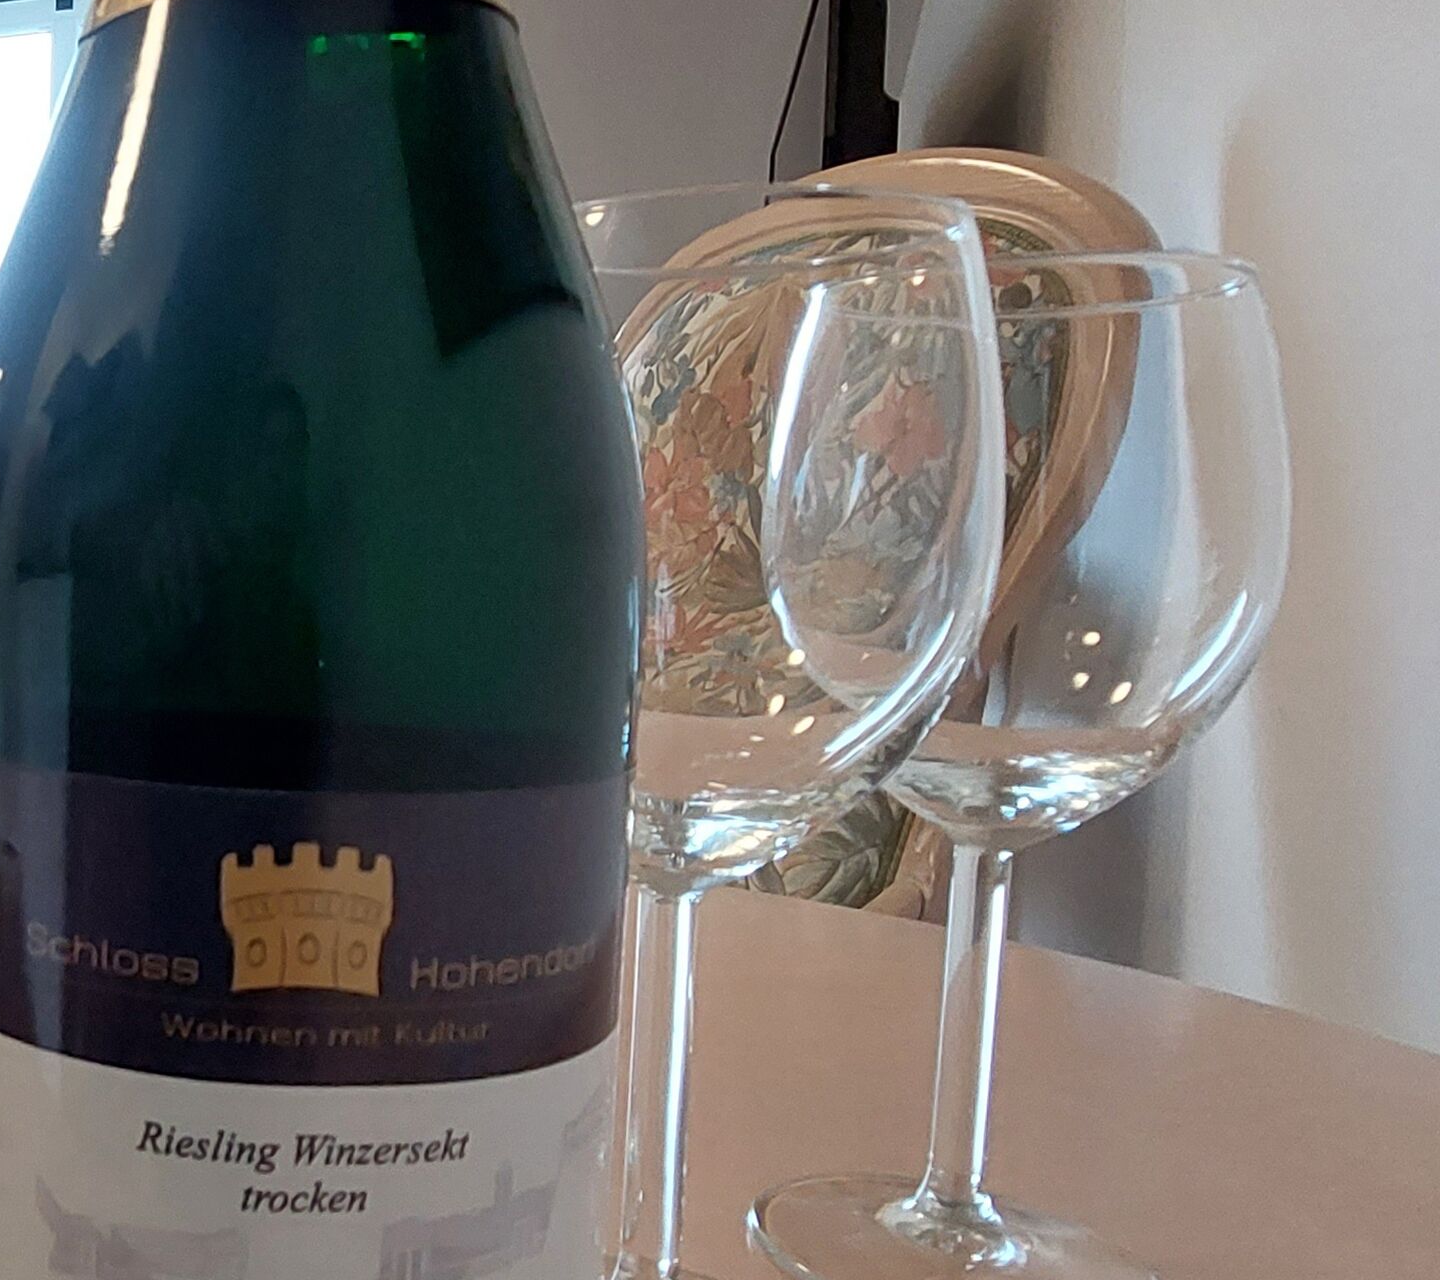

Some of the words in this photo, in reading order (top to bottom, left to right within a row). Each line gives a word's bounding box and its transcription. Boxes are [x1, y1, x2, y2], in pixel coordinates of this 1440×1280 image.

[24, 920, 200, 986] Schloss
[161, 1013, 317, 1047] Wohnen
[328, 1023, 385, 1047] mit
[395, 1020, 490, 1046] Kultur
[136, 1120, 281, 1173] Riesling
[293, 1128, 471, 1167] Winzersekt
[240, 1181, 369, 1215] trocken
